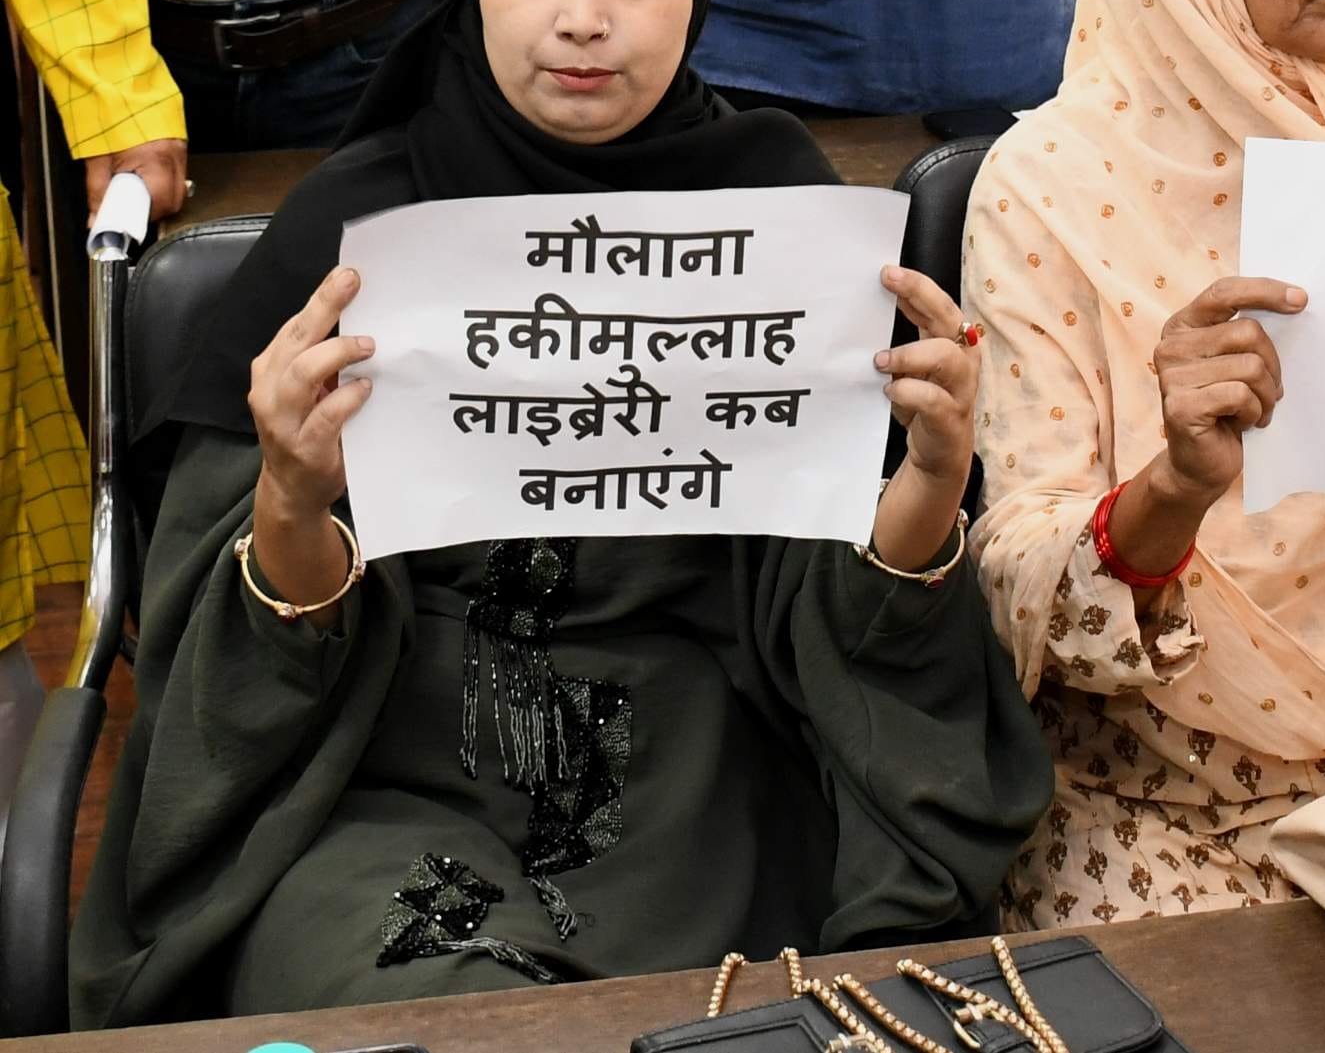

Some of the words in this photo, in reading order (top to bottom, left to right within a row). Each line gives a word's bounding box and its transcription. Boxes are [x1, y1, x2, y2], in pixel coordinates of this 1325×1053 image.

[525, 214, 754, 279] मौलाना
[464, 292, 805, 385] हकीमुल्लाह
[449, 379, 670, 446] लाइब्रेरी
[705, 389, 811, 430] कब
[519, 448, 732, 512] बनाएंगे
